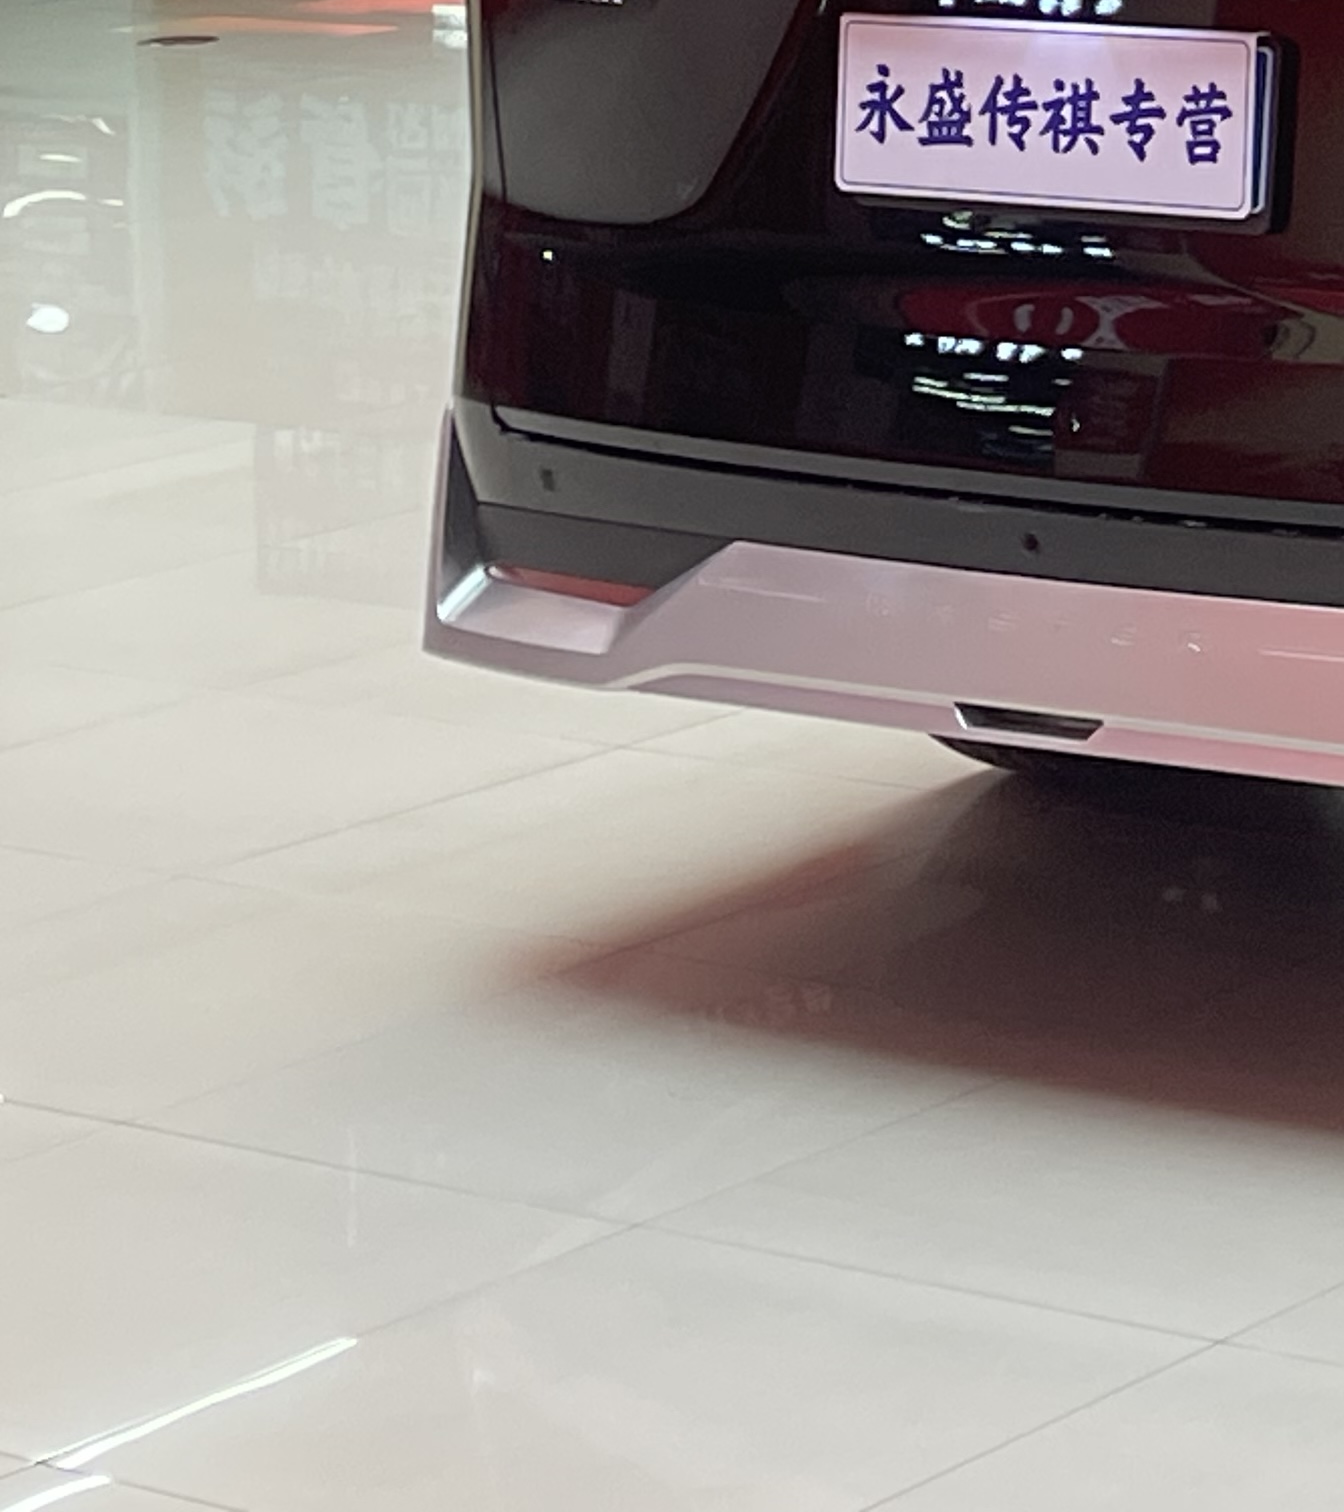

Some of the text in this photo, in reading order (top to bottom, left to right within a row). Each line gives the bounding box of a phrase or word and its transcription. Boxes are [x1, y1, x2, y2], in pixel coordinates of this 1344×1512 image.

[855, 63, 1233, 165] 永盛传祺专营
